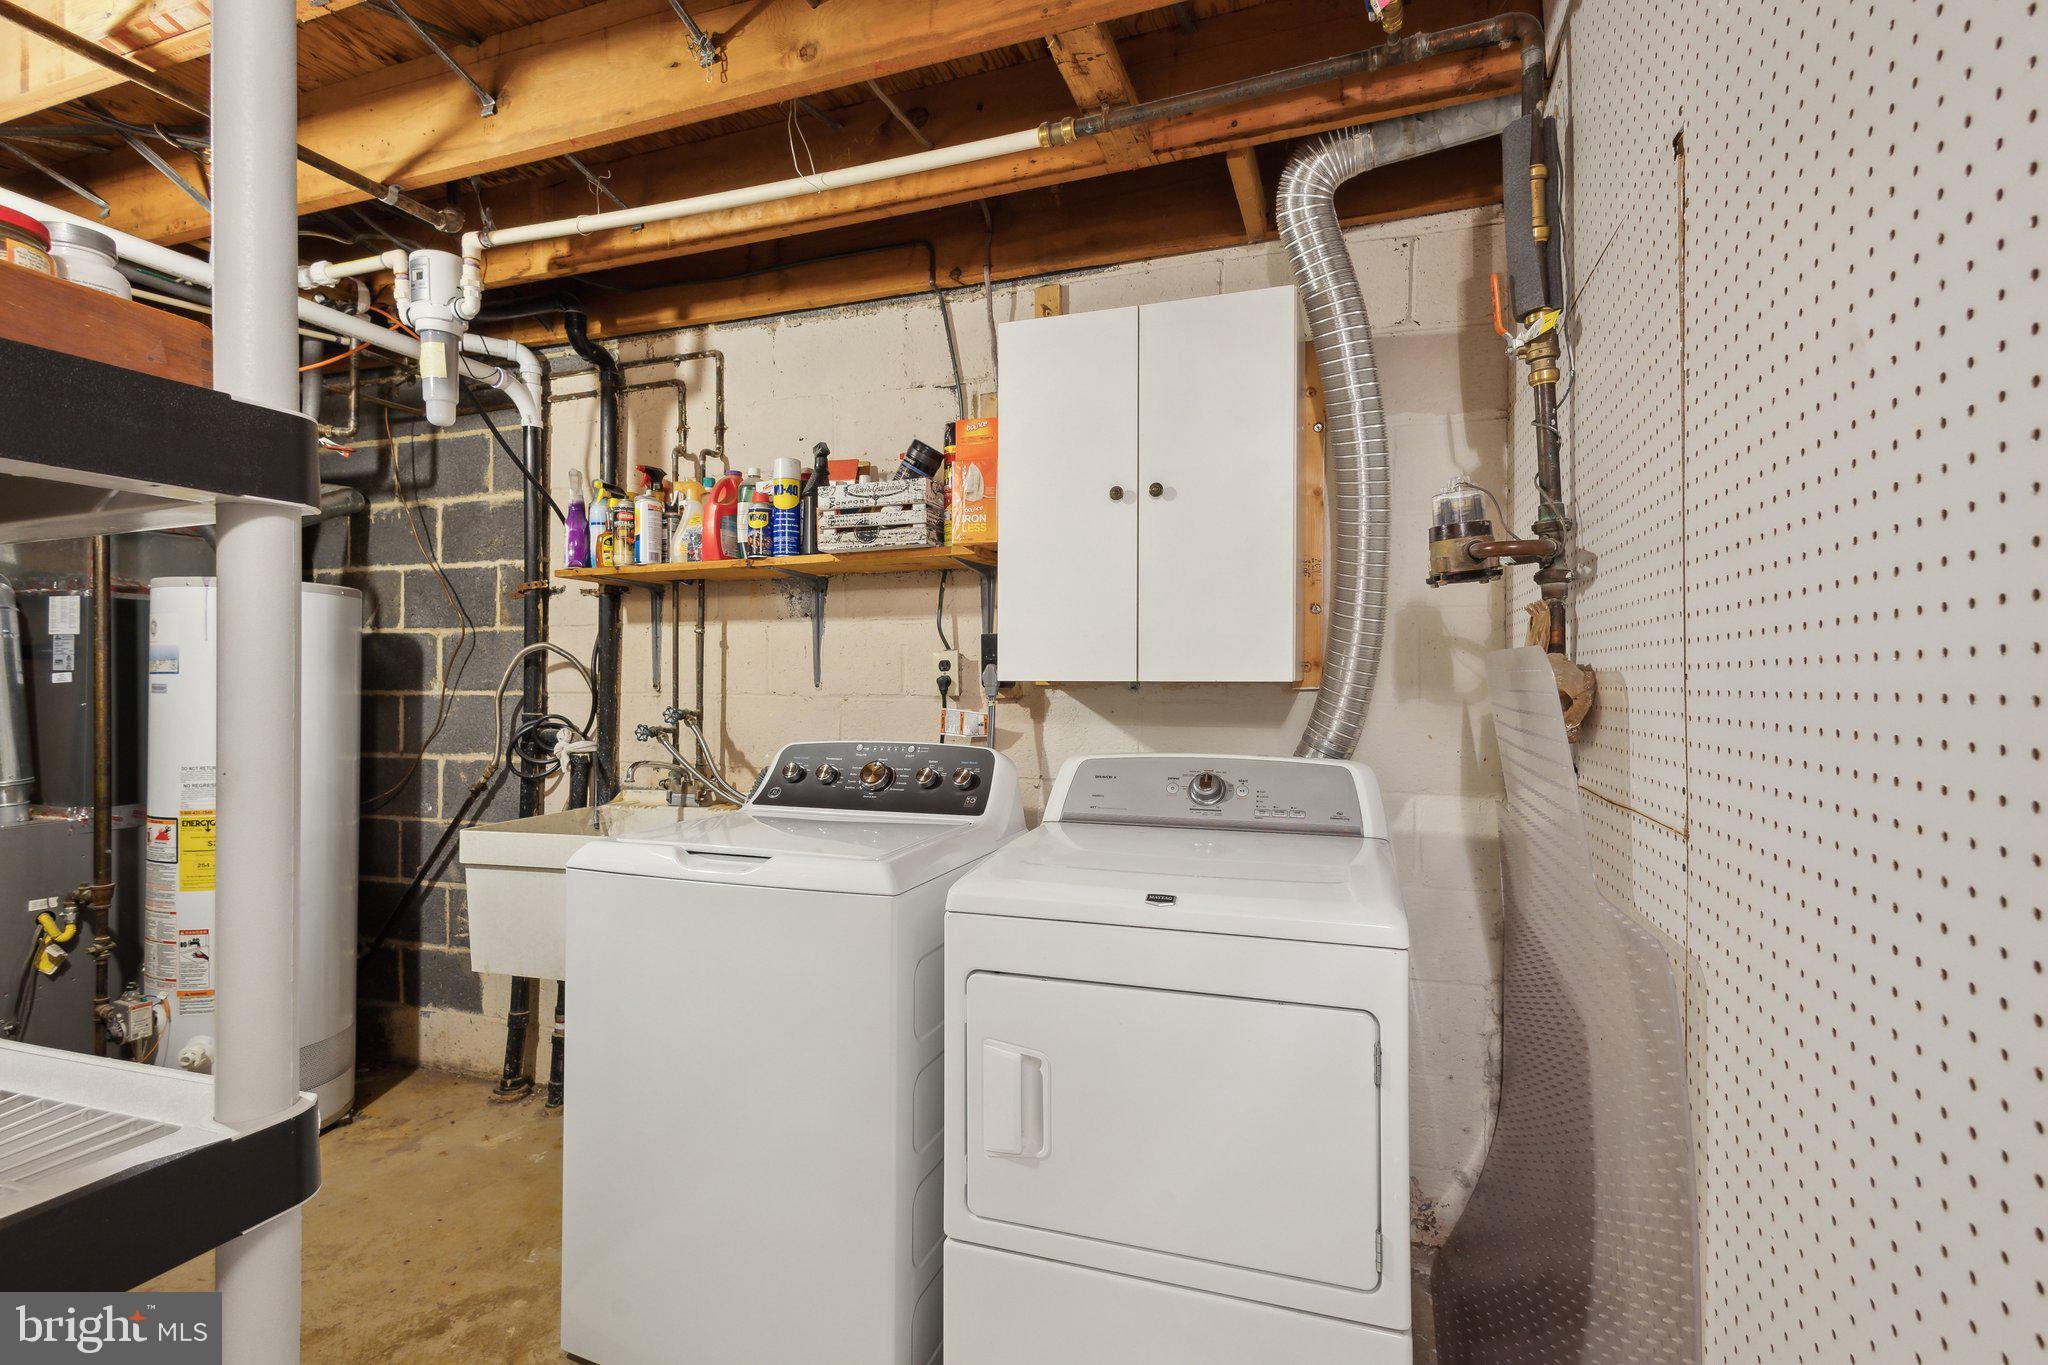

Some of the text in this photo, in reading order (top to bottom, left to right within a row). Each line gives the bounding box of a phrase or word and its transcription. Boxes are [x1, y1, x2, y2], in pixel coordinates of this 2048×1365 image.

[773, 484, 799, 496] WD-40
[749, 513, 767, 521] WD-40
[962, 523, 987, 532] LESS
